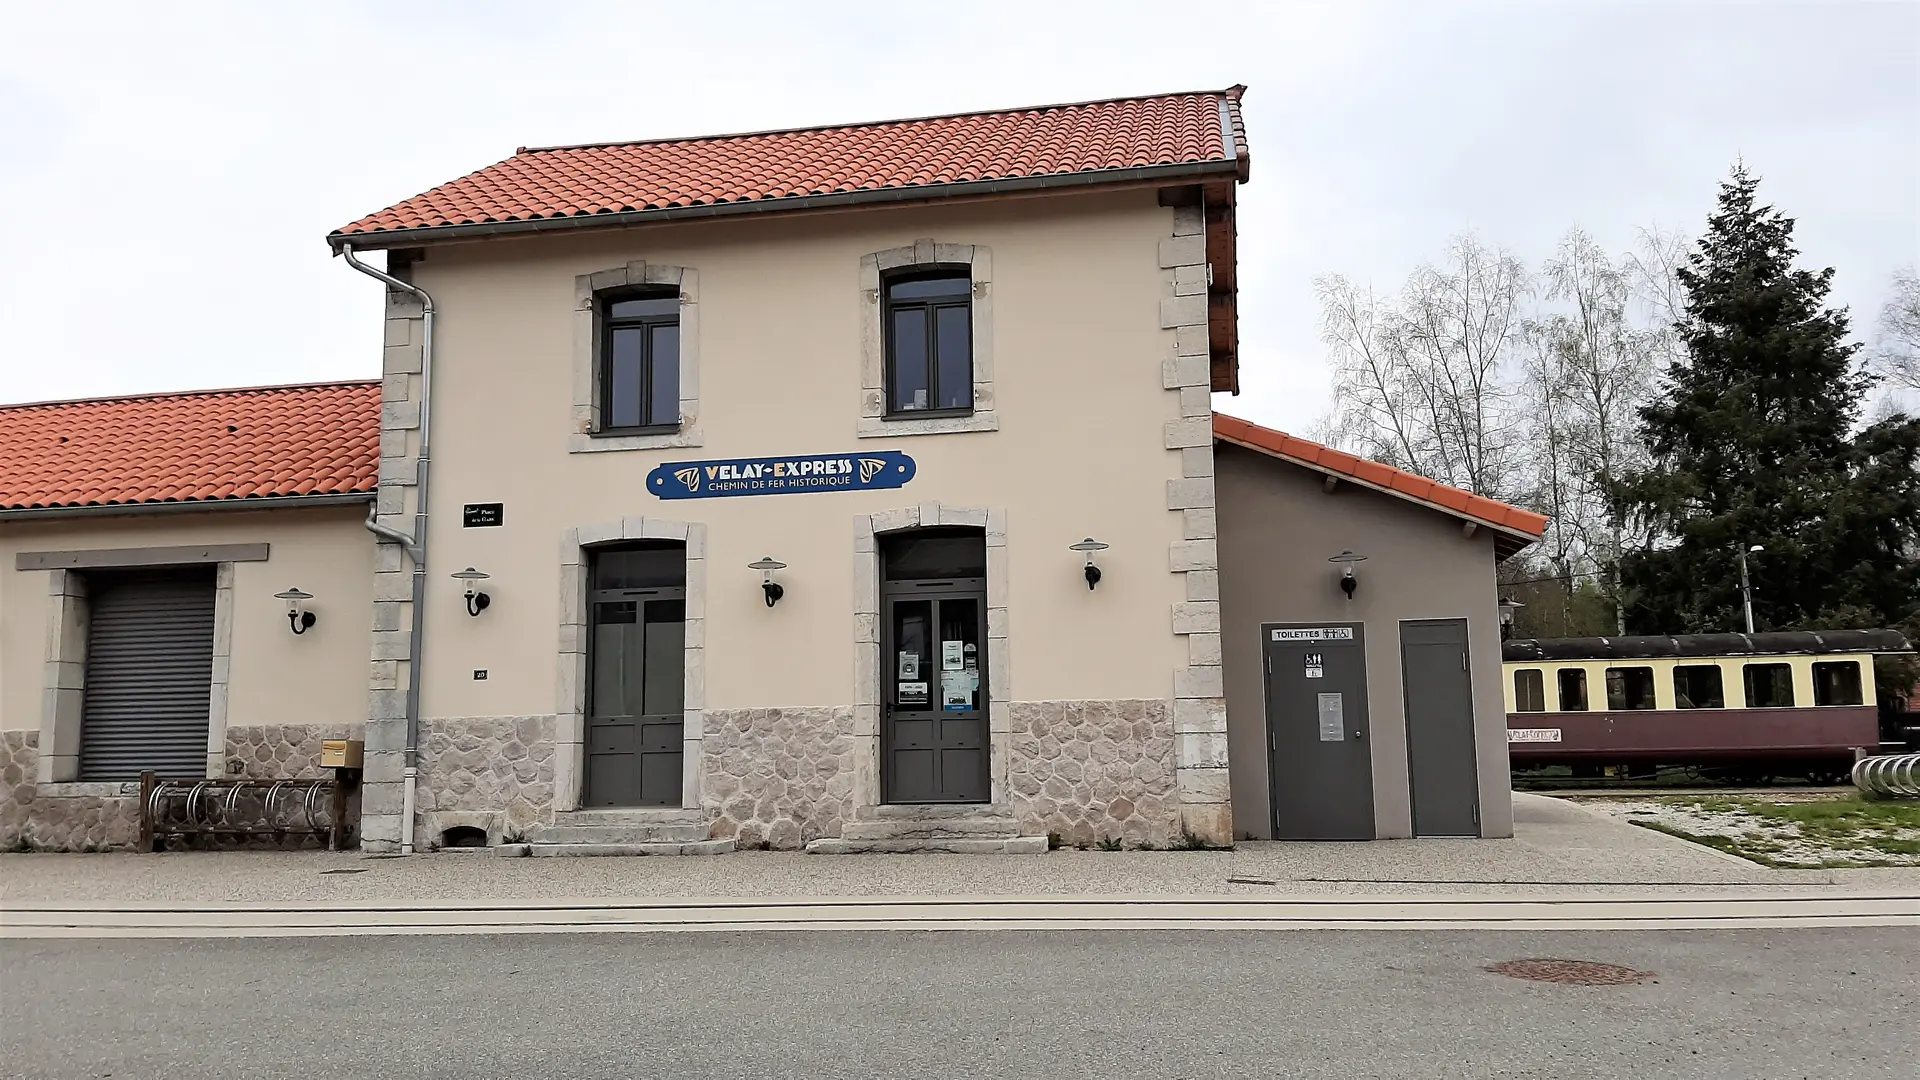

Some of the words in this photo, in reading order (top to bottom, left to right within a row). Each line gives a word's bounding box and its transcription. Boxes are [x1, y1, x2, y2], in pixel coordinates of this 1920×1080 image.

[705, 459, 853, 480] VELAY-EXPRESS
[708, 481, 748, 491] CHEMIN
[752, 480, 765, 489] DE
[768, 479, 785, 488] FER
[789, 476, 850, 487] HISTORIQUE
[1276, 630, 1320, 638] TOILETTES
